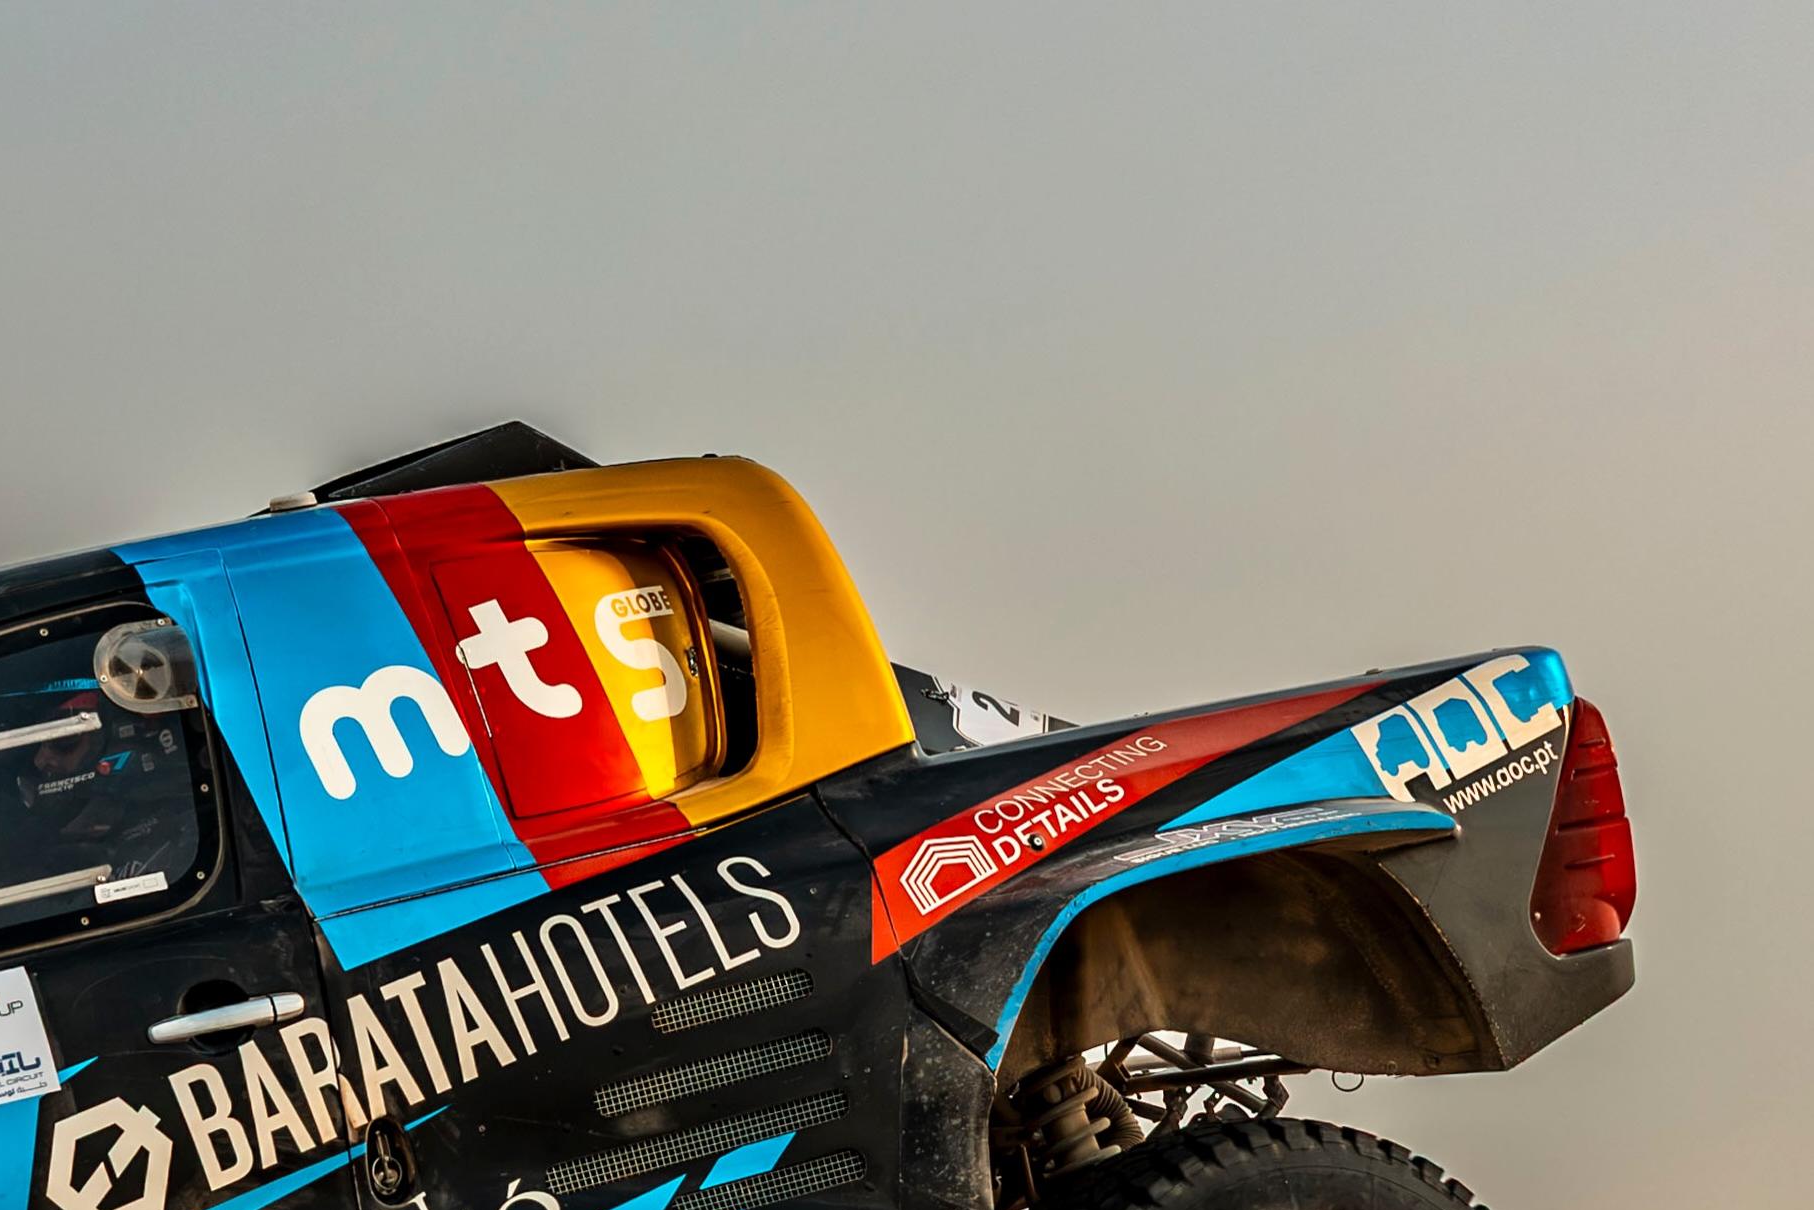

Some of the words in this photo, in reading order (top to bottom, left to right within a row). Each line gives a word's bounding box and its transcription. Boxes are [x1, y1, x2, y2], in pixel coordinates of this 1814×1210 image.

[610, 591, 672, 618] GLOBE
[298, 584, 688, 801] mts
[973, 734, 1169, 834] CONNECTING
[1442, 738, 1560, 815] www.aoc.pt
[991, 777, 1126, 867] DETAILS
[6, 1071, 44, 1087] CIRCUIT
